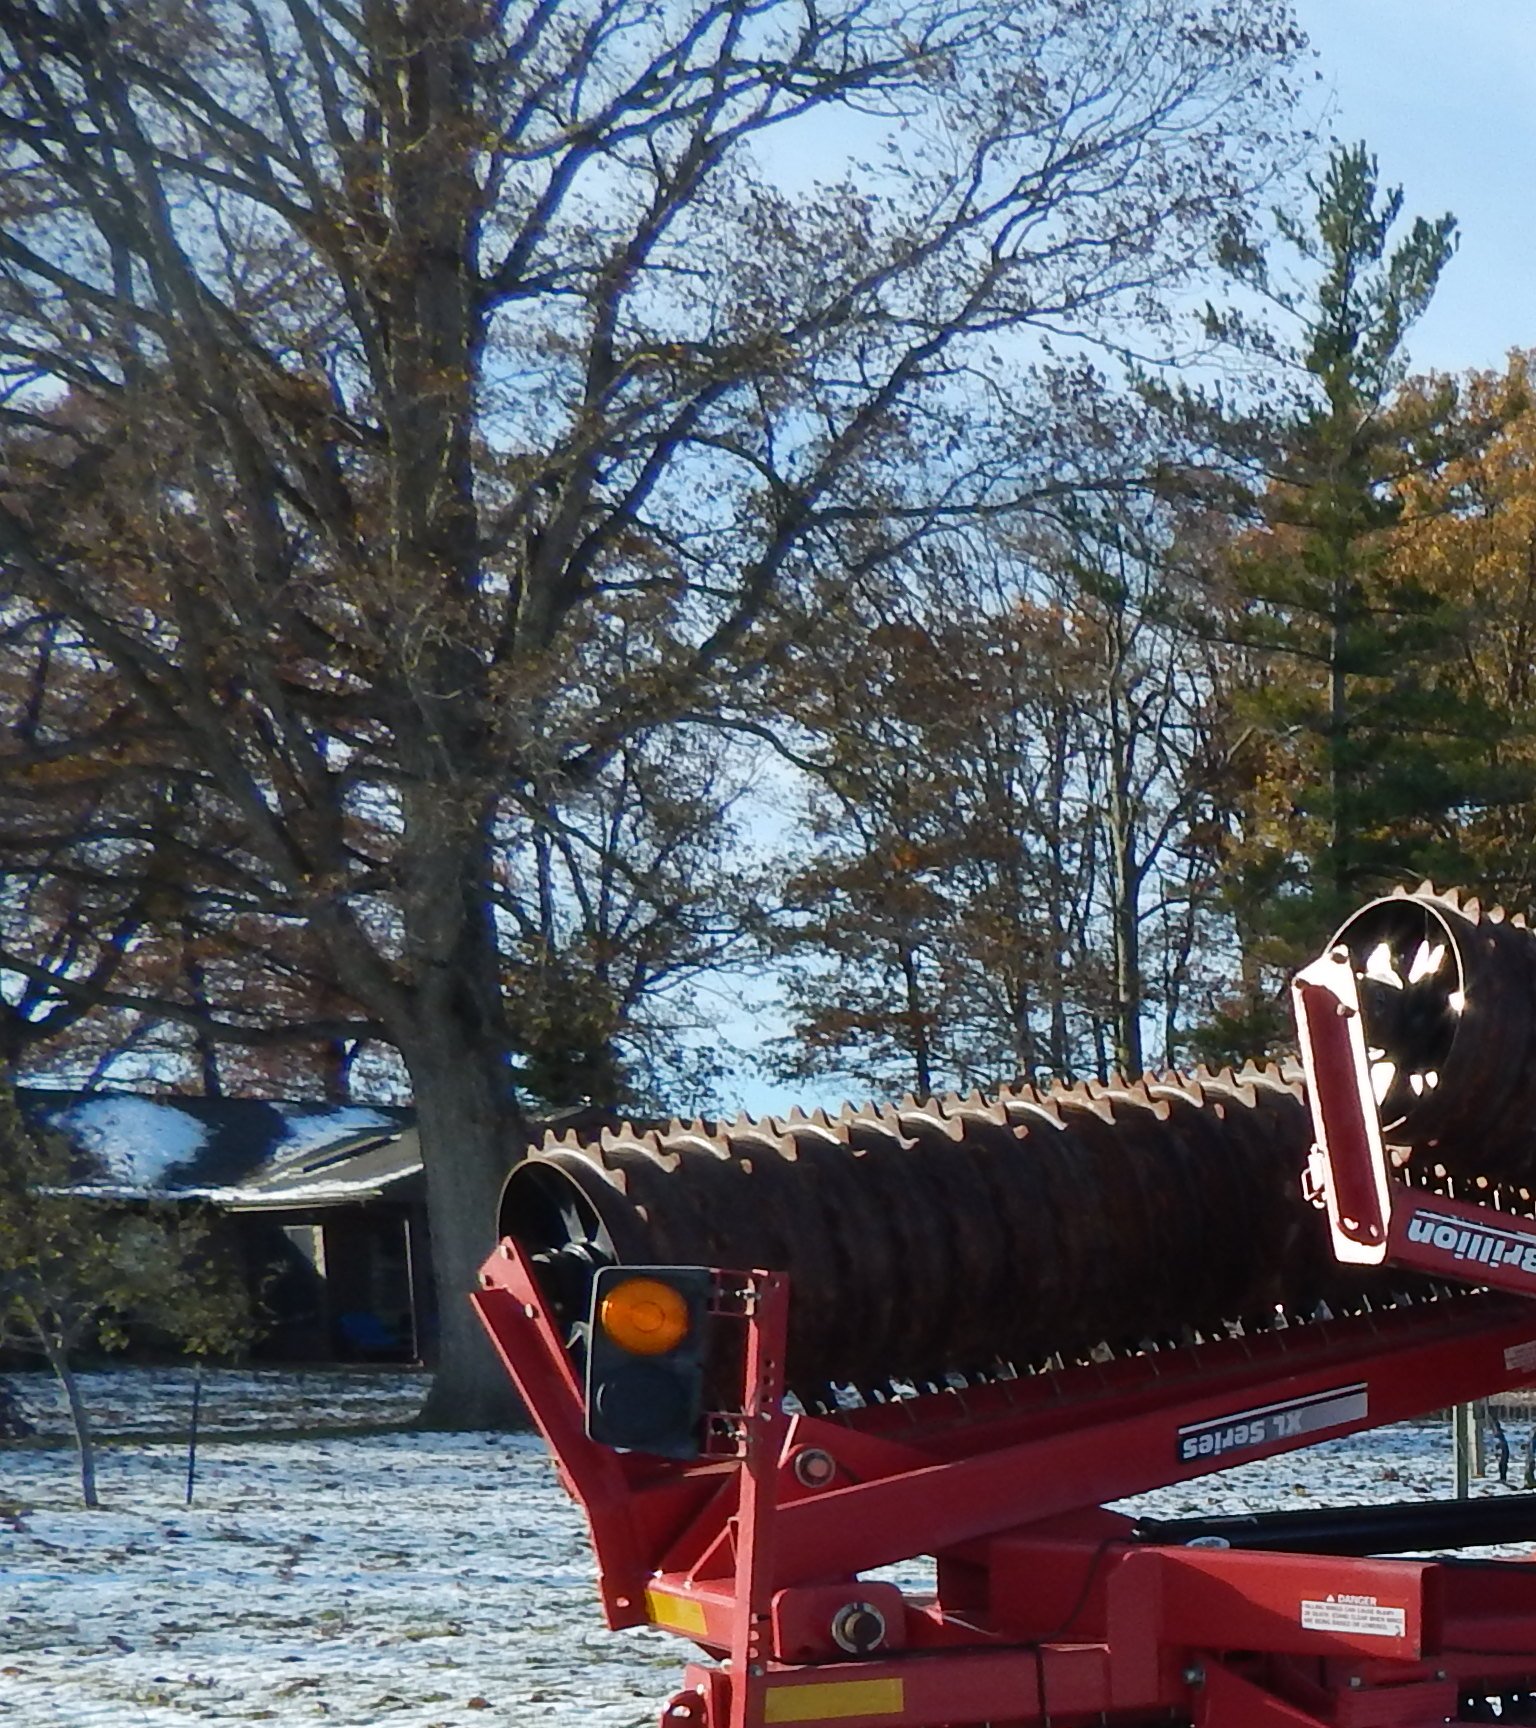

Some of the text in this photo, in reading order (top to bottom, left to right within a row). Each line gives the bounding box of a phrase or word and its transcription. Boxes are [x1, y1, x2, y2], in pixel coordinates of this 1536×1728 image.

[1182, 1409, 1303, 1459] XL Series
[1337, 1593, 1377, 1607] DANGER
